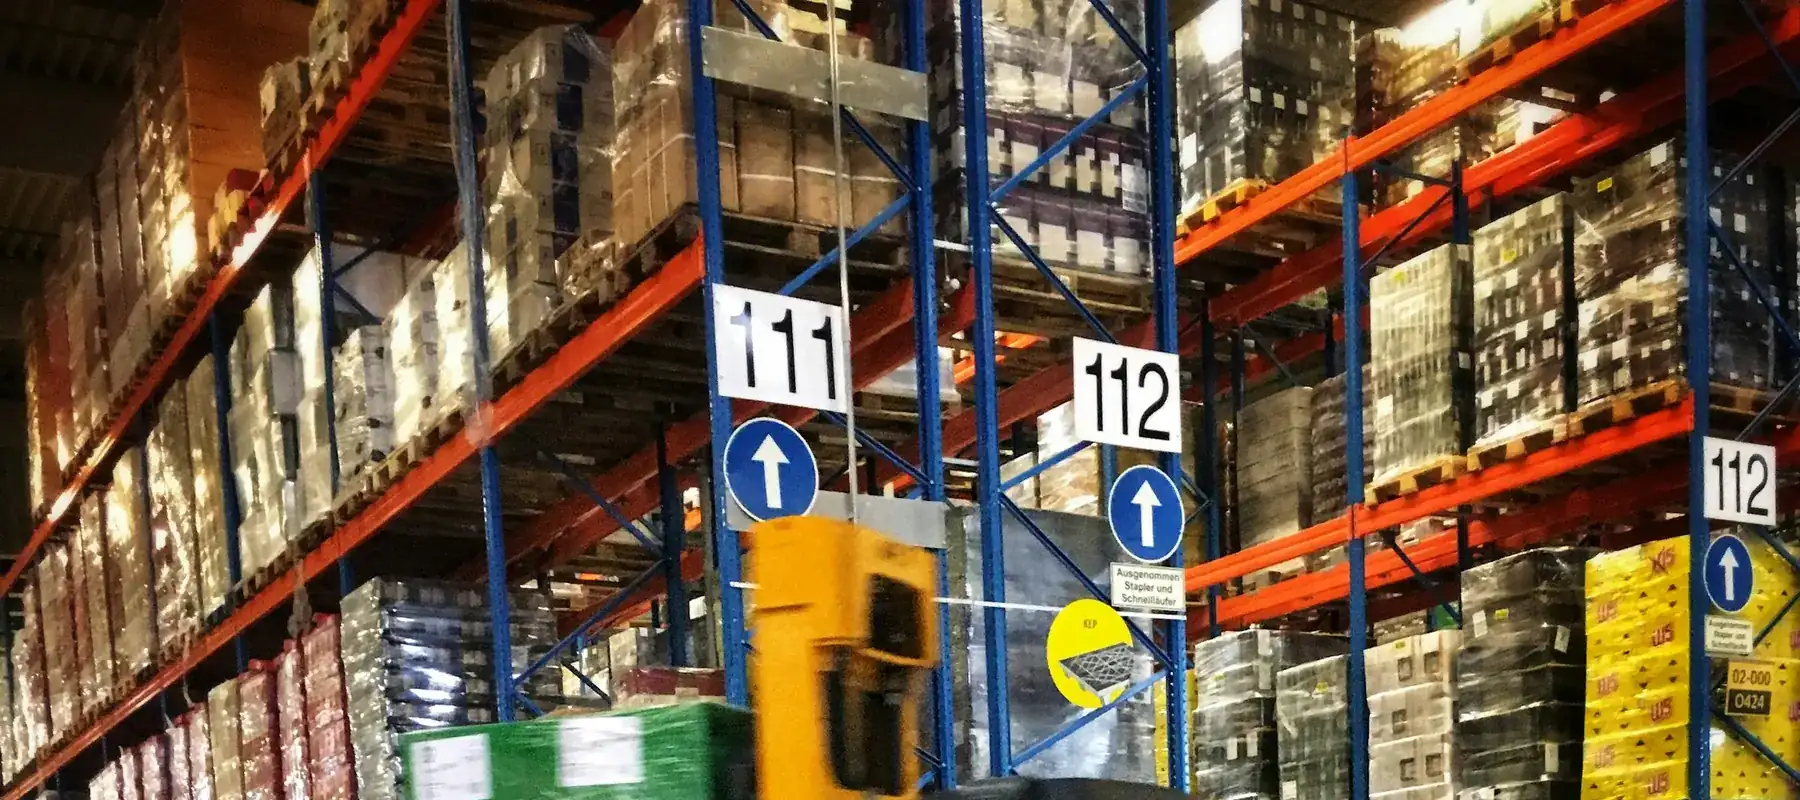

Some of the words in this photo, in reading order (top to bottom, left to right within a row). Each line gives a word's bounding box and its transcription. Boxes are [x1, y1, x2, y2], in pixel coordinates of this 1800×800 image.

[730, 301, 836, 400] 111
[1085, 352, 1170, 441] 112
[1711, 447, 1769, 517] 112
[1116, 568, 1180, 582] Ausgenommen
[1124, 581, 1154, 592] Stapler
[1156, 584, 1173, 594] und
[1732, 668, 1772, 686] 02-000
